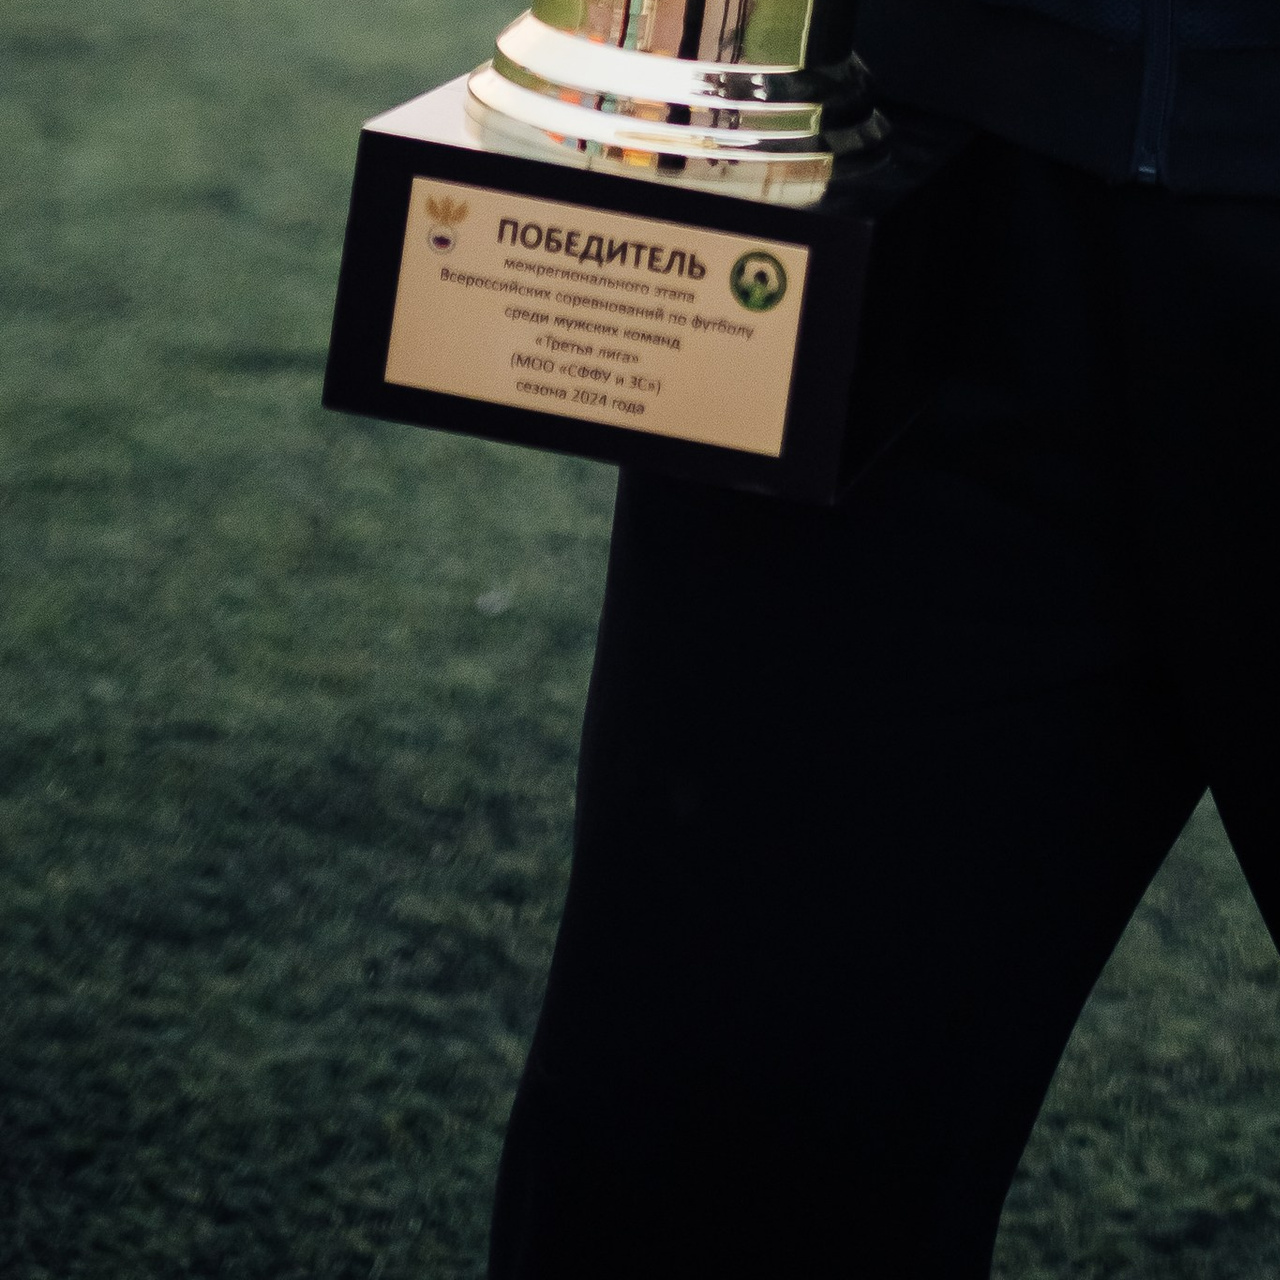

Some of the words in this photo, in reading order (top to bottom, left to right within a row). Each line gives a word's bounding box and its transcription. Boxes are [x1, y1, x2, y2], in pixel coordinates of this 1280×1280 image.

[497, 218, 706, 280] ПОБЕДИТЕЛЬ
[503, 257, 650, 295] межрегионального
[655, 286, 695, 304] этапа
[440, 267, 551, 300] Всероссийских
[556, 291, 665, 323] соревнований
[692, 315, 754, 340] футболу
[504, 307, 549, 325] среди
[553, 315, 619, 335] мужских
[623, 329, 681, 351] команд
[516, 380, 567, 399] сезона
[571, 389, 608, 407] 2024
[612, 399, 646, 416] года
[615, 375, 625, 386] и
